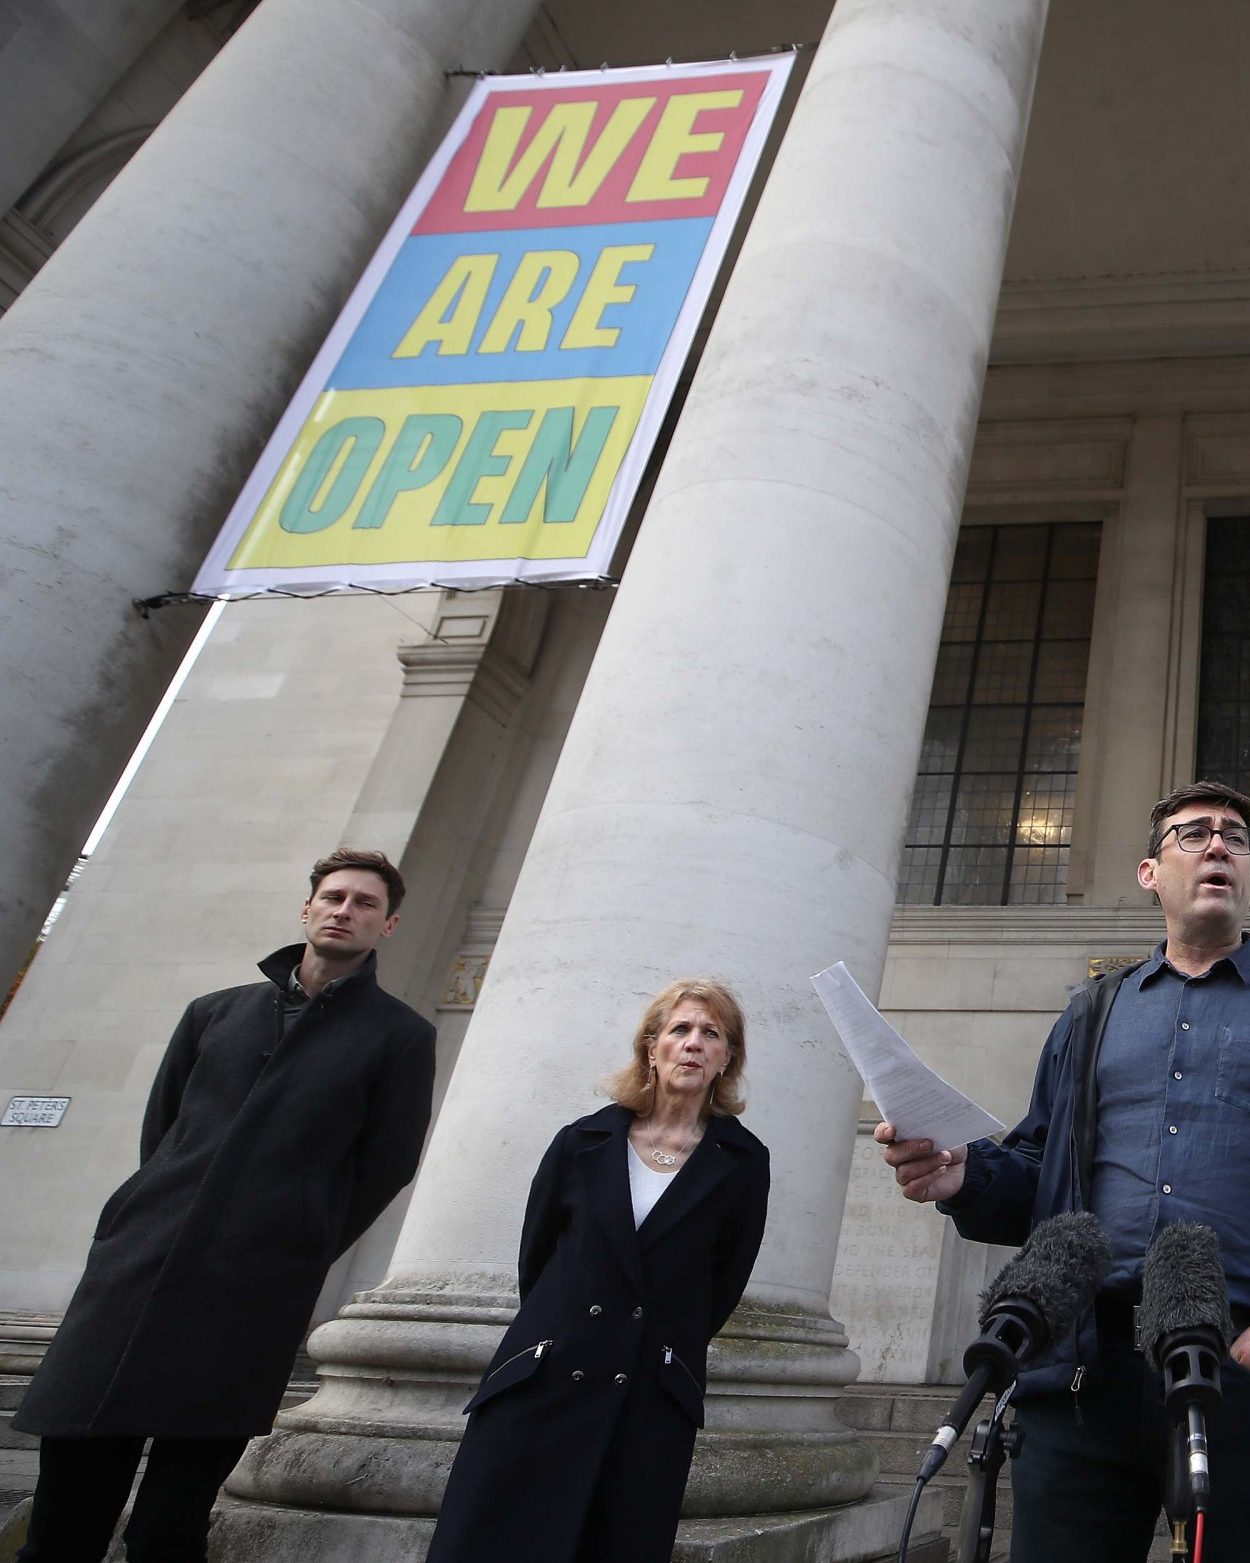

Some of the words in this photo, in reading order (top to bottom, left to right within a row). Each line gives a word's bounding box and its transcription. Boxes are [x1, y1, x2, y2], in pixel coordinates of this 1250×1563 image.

[462, 89, 745, 213] WE
[390, 243, 657, 360] ARE
[278, 405, 620, 535] OPEN
[9, 1112, 55, 1124] SQUARE
